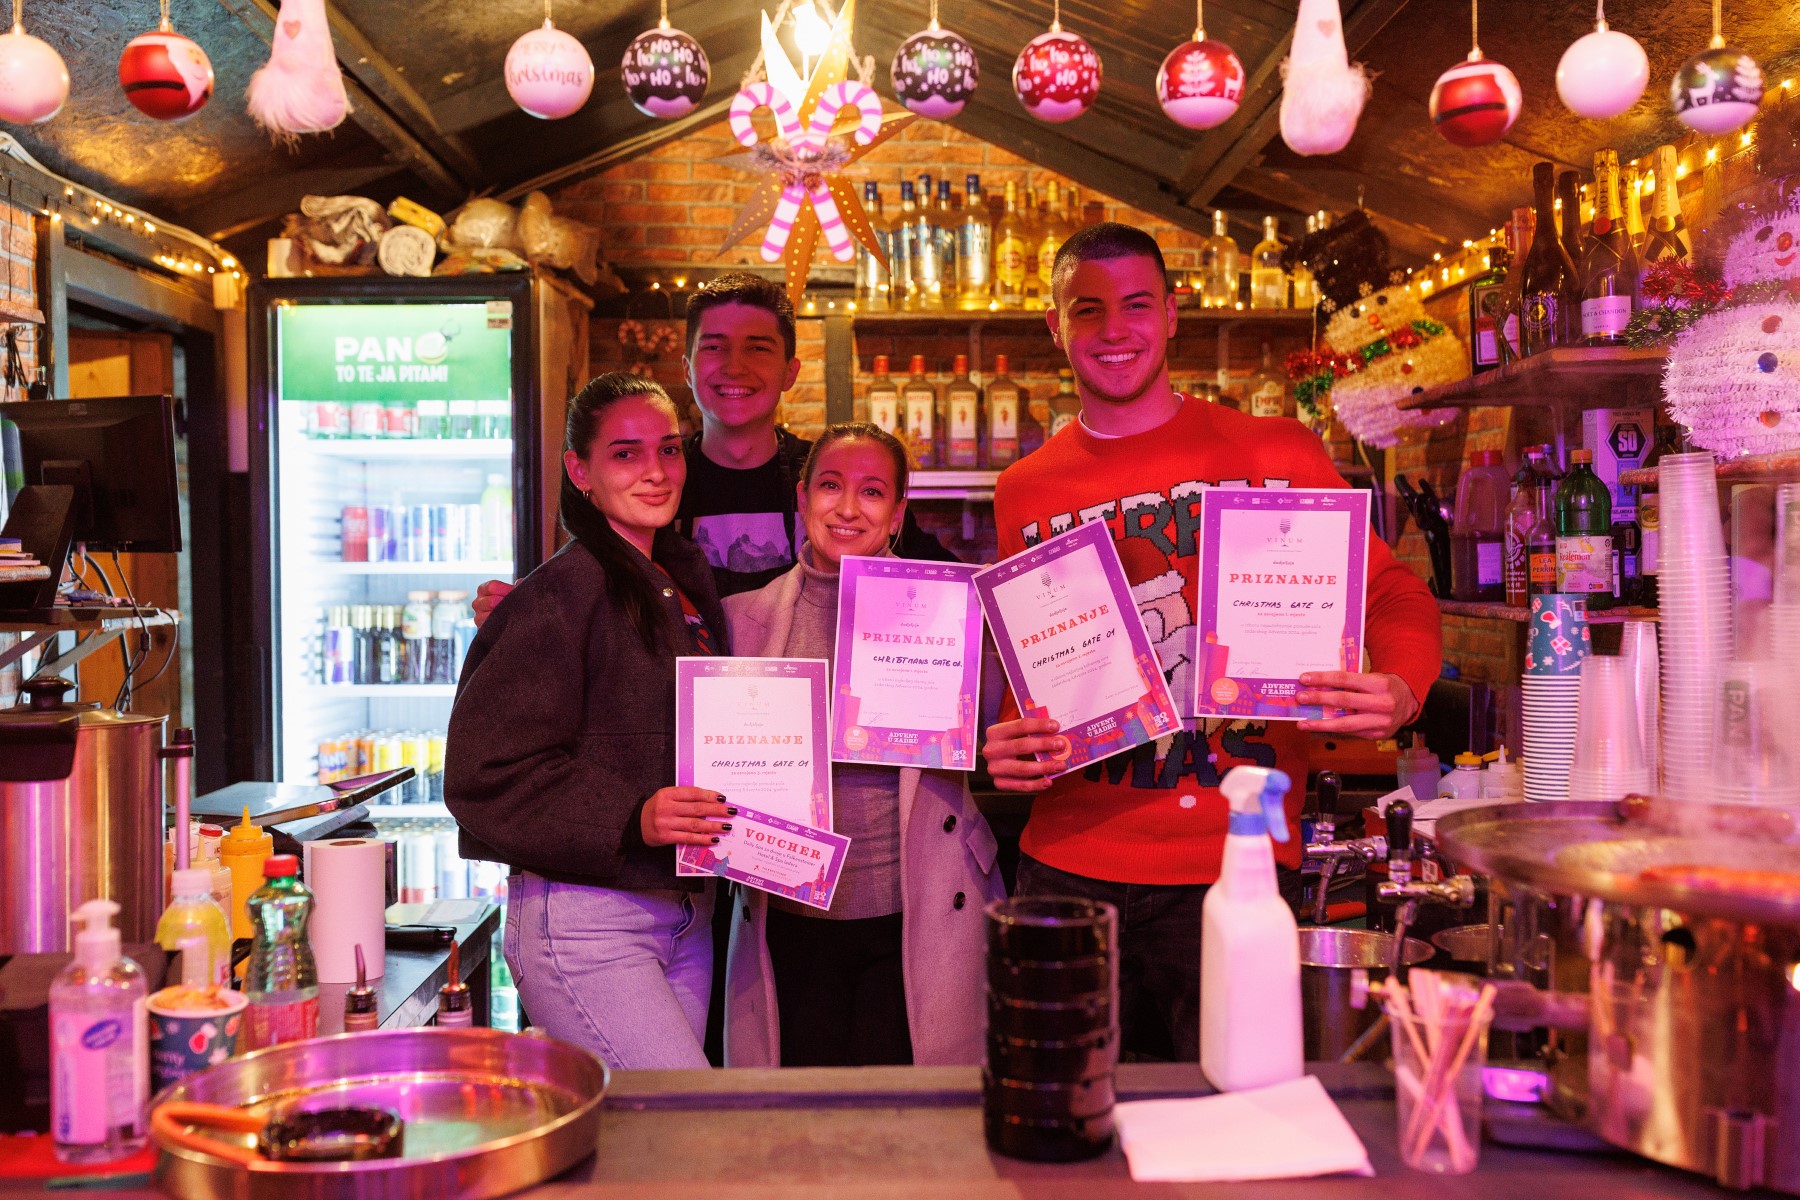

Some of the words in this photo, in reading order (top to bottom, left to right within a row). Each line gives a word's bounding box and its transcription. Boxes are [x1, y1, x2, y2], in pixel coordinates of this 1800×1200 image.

[651, 39, 672, 54] HO
[673, 47, 694, 63] HO
[920, 43, 941, 63] ho
[1050, 46, 1070, 64] ho
[650, 68, 672, 86] HO
[926, 67, 949, 85] HO
[1055, 69, 1078, 86] HO
[335, 365, 356, 383] TO
[357, 365, 375, 383] TE
[375, 365, 397, 383] JA
[399, 365, 449, 383] PITAM!
[1229, 573, 1337, 585] PRIZNANJE
[1036, 584, 1066, 600] VINUM
[895, 601, 927, 609] VINUM
[1233, 599, 1282, 609] CHRISTMAS
[1290, 601, 1314, 609] GATE
[1020, 604, 1109, 649] PRIZNANJE
[862, 631, 956, 647] PRIZNANJE
[1032, 646, 1075, 669] CHRISTMAS
[1082, 633, 1101, 648] GATE
[931, 658, 951, 667] GATE
[1086, 716, 1115, 732] ADVENT
[703, 735, 803, 745] PRIZNANJE
[711, 760, 767, 768] CHRISTMAS
[773, 760, 795, 768] GATE
[745, 828, 822, 860] VOUCHER
